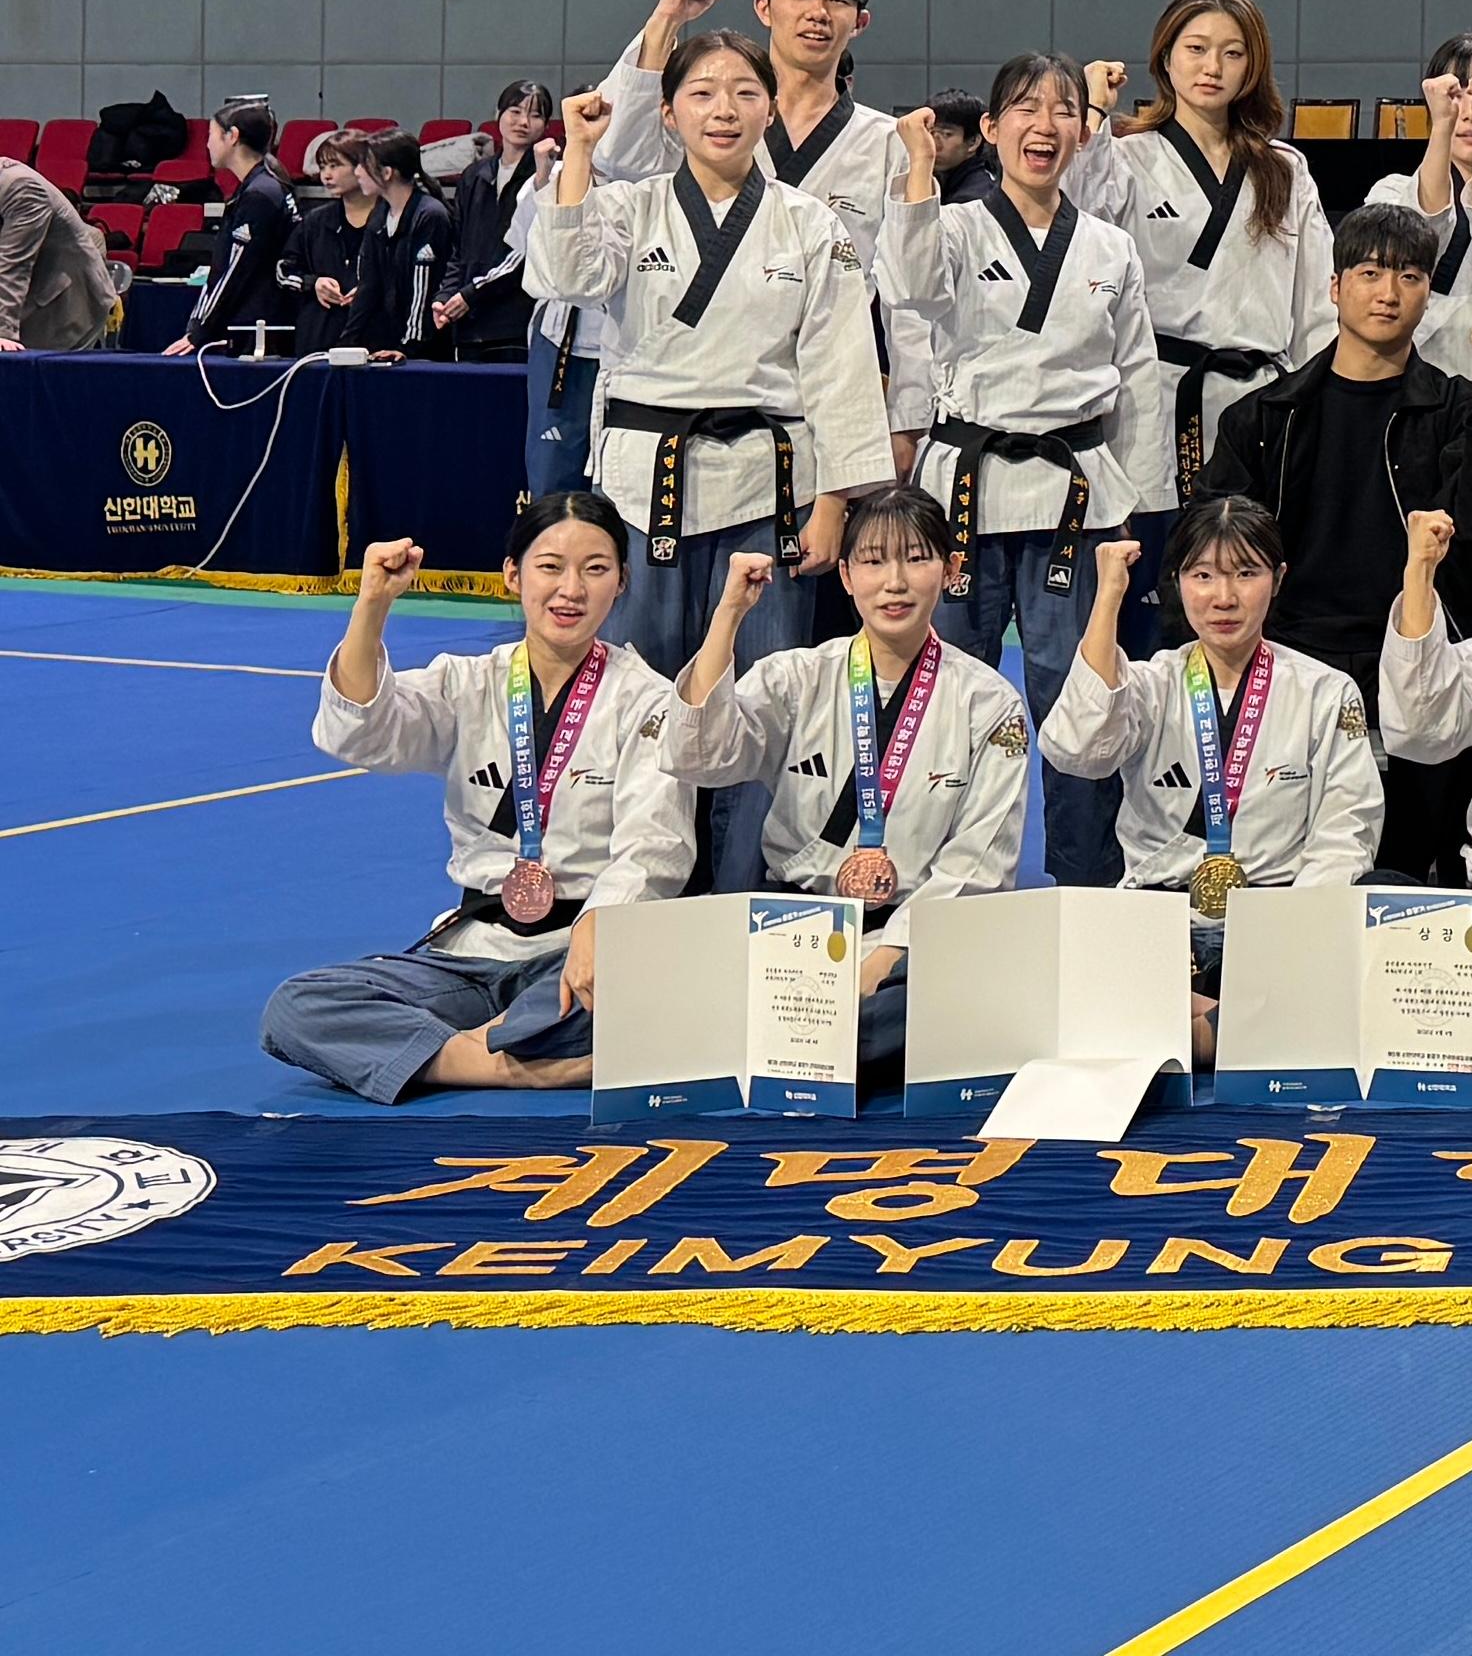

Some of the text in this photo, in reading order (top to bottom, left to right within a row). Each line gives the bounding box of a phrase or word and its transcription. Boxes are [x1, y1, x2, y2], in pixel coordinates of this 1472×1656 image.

[104, 495, 196, 522] 신한대학교
[512, 691, 535, 832] 제5회 신한대학교 전국
[539, 728, 575, 795] 신한대학교
[565, 698, 587, 724] 전국
[854, 681, 877, 821] 제5회 신한대학교 전국
[883, 716, 917, 780] 신한대학교
[1194, 688, 1224, 826] 제5회 신한대학교 전국
[1226, 724, 1254, 789] 신한대학교
[1245, 694, 1263, 720] 전국
[282, 1233, 1456, 1278] KEIMYUNG
